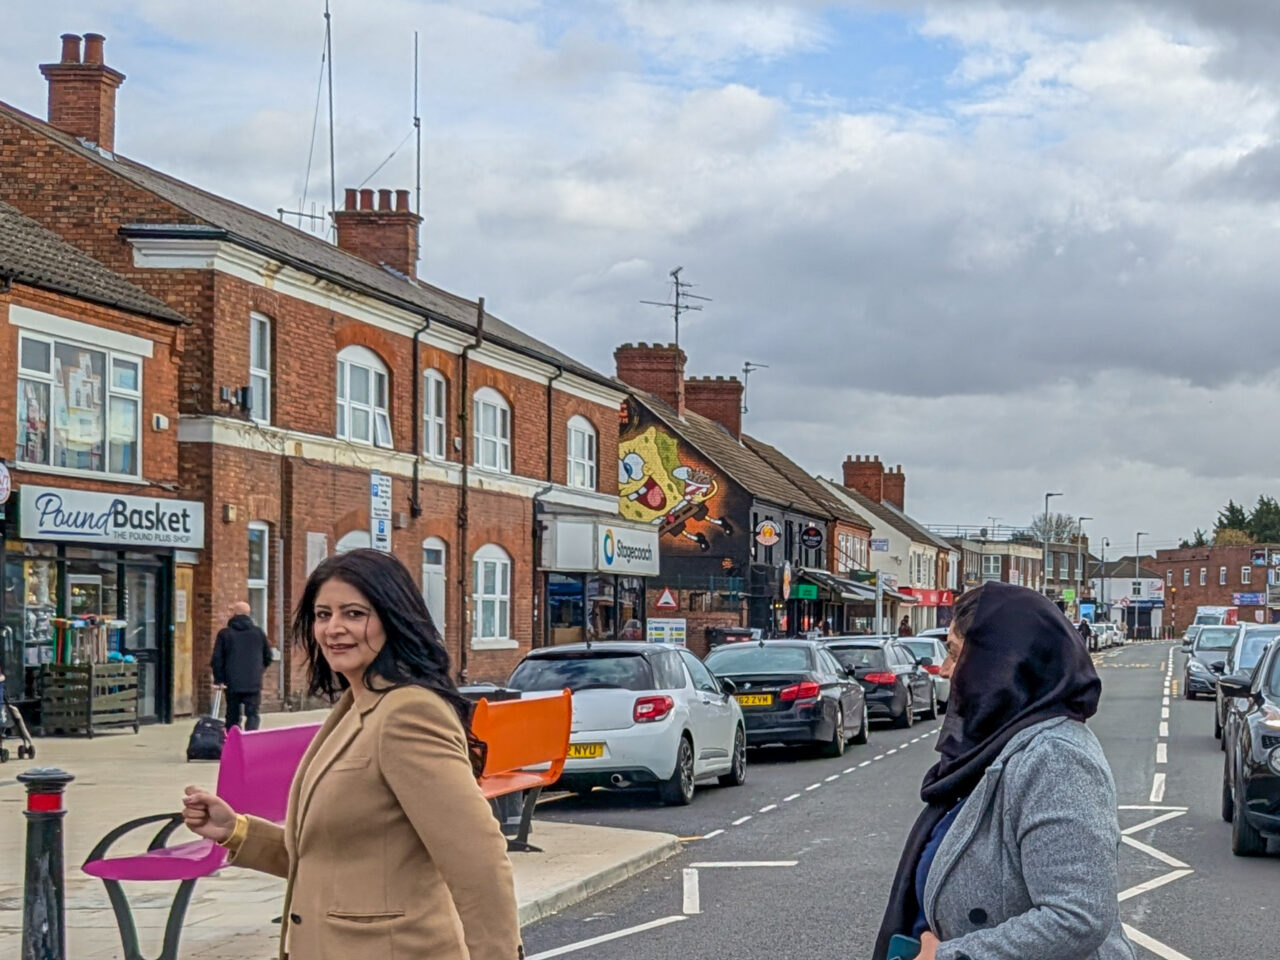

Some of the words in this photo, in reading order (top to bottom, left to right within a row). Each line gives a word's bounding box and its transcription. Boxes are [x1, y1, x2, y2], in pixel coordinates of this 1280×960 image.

[114, 531, 127, 540] THE
[129, 532, 153, 542] POUND
[154, 534, 172, 543] PLUS
[173, 535, 191, 544] SHOP
[617, 539, 652, 564] Stagecoach
[574, 745, 597, 757] NYU
